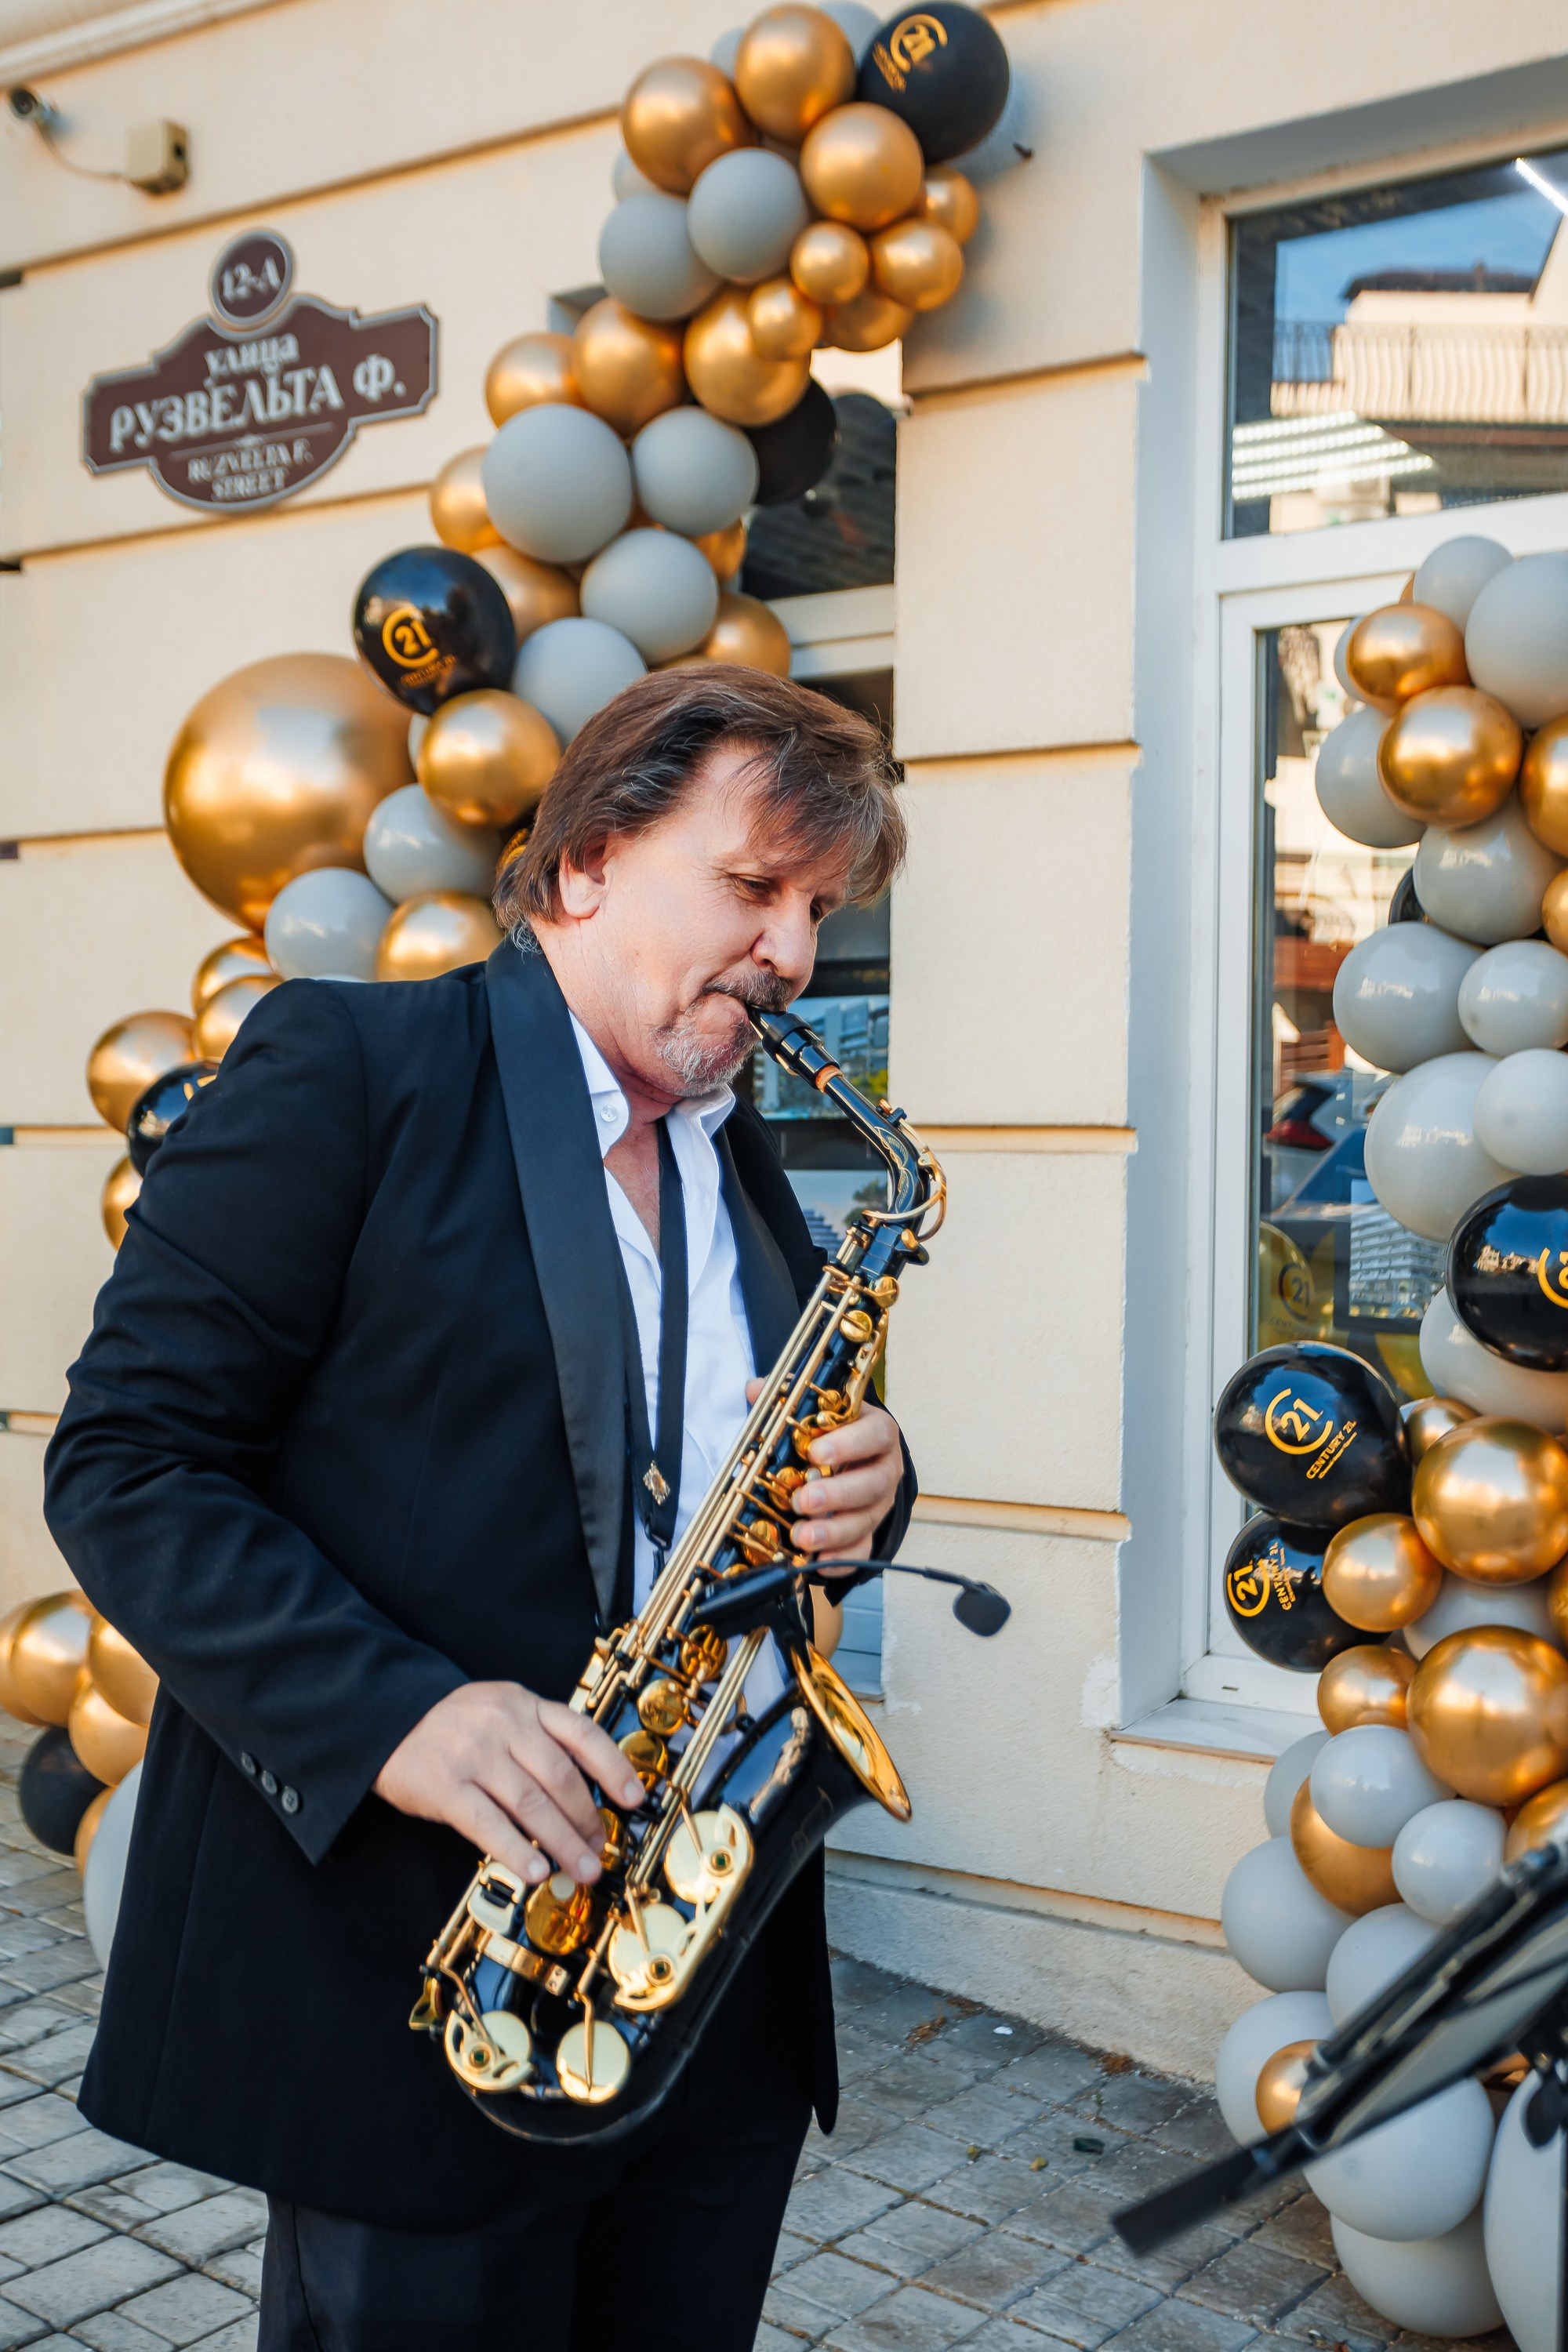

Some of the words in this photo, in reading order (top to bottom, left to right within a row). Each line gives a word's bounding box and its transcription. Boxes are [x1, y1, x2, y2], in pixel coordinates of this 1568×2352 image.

[202, 332, 299, 390] улица
[108, 364, 344, 453] РУЗВЕЛЬТА
[351, 353, 407, 401] Ф.
[210, 466, 289, 503] STREET
[1306, 1430, 1345, 1479] CENTURY
